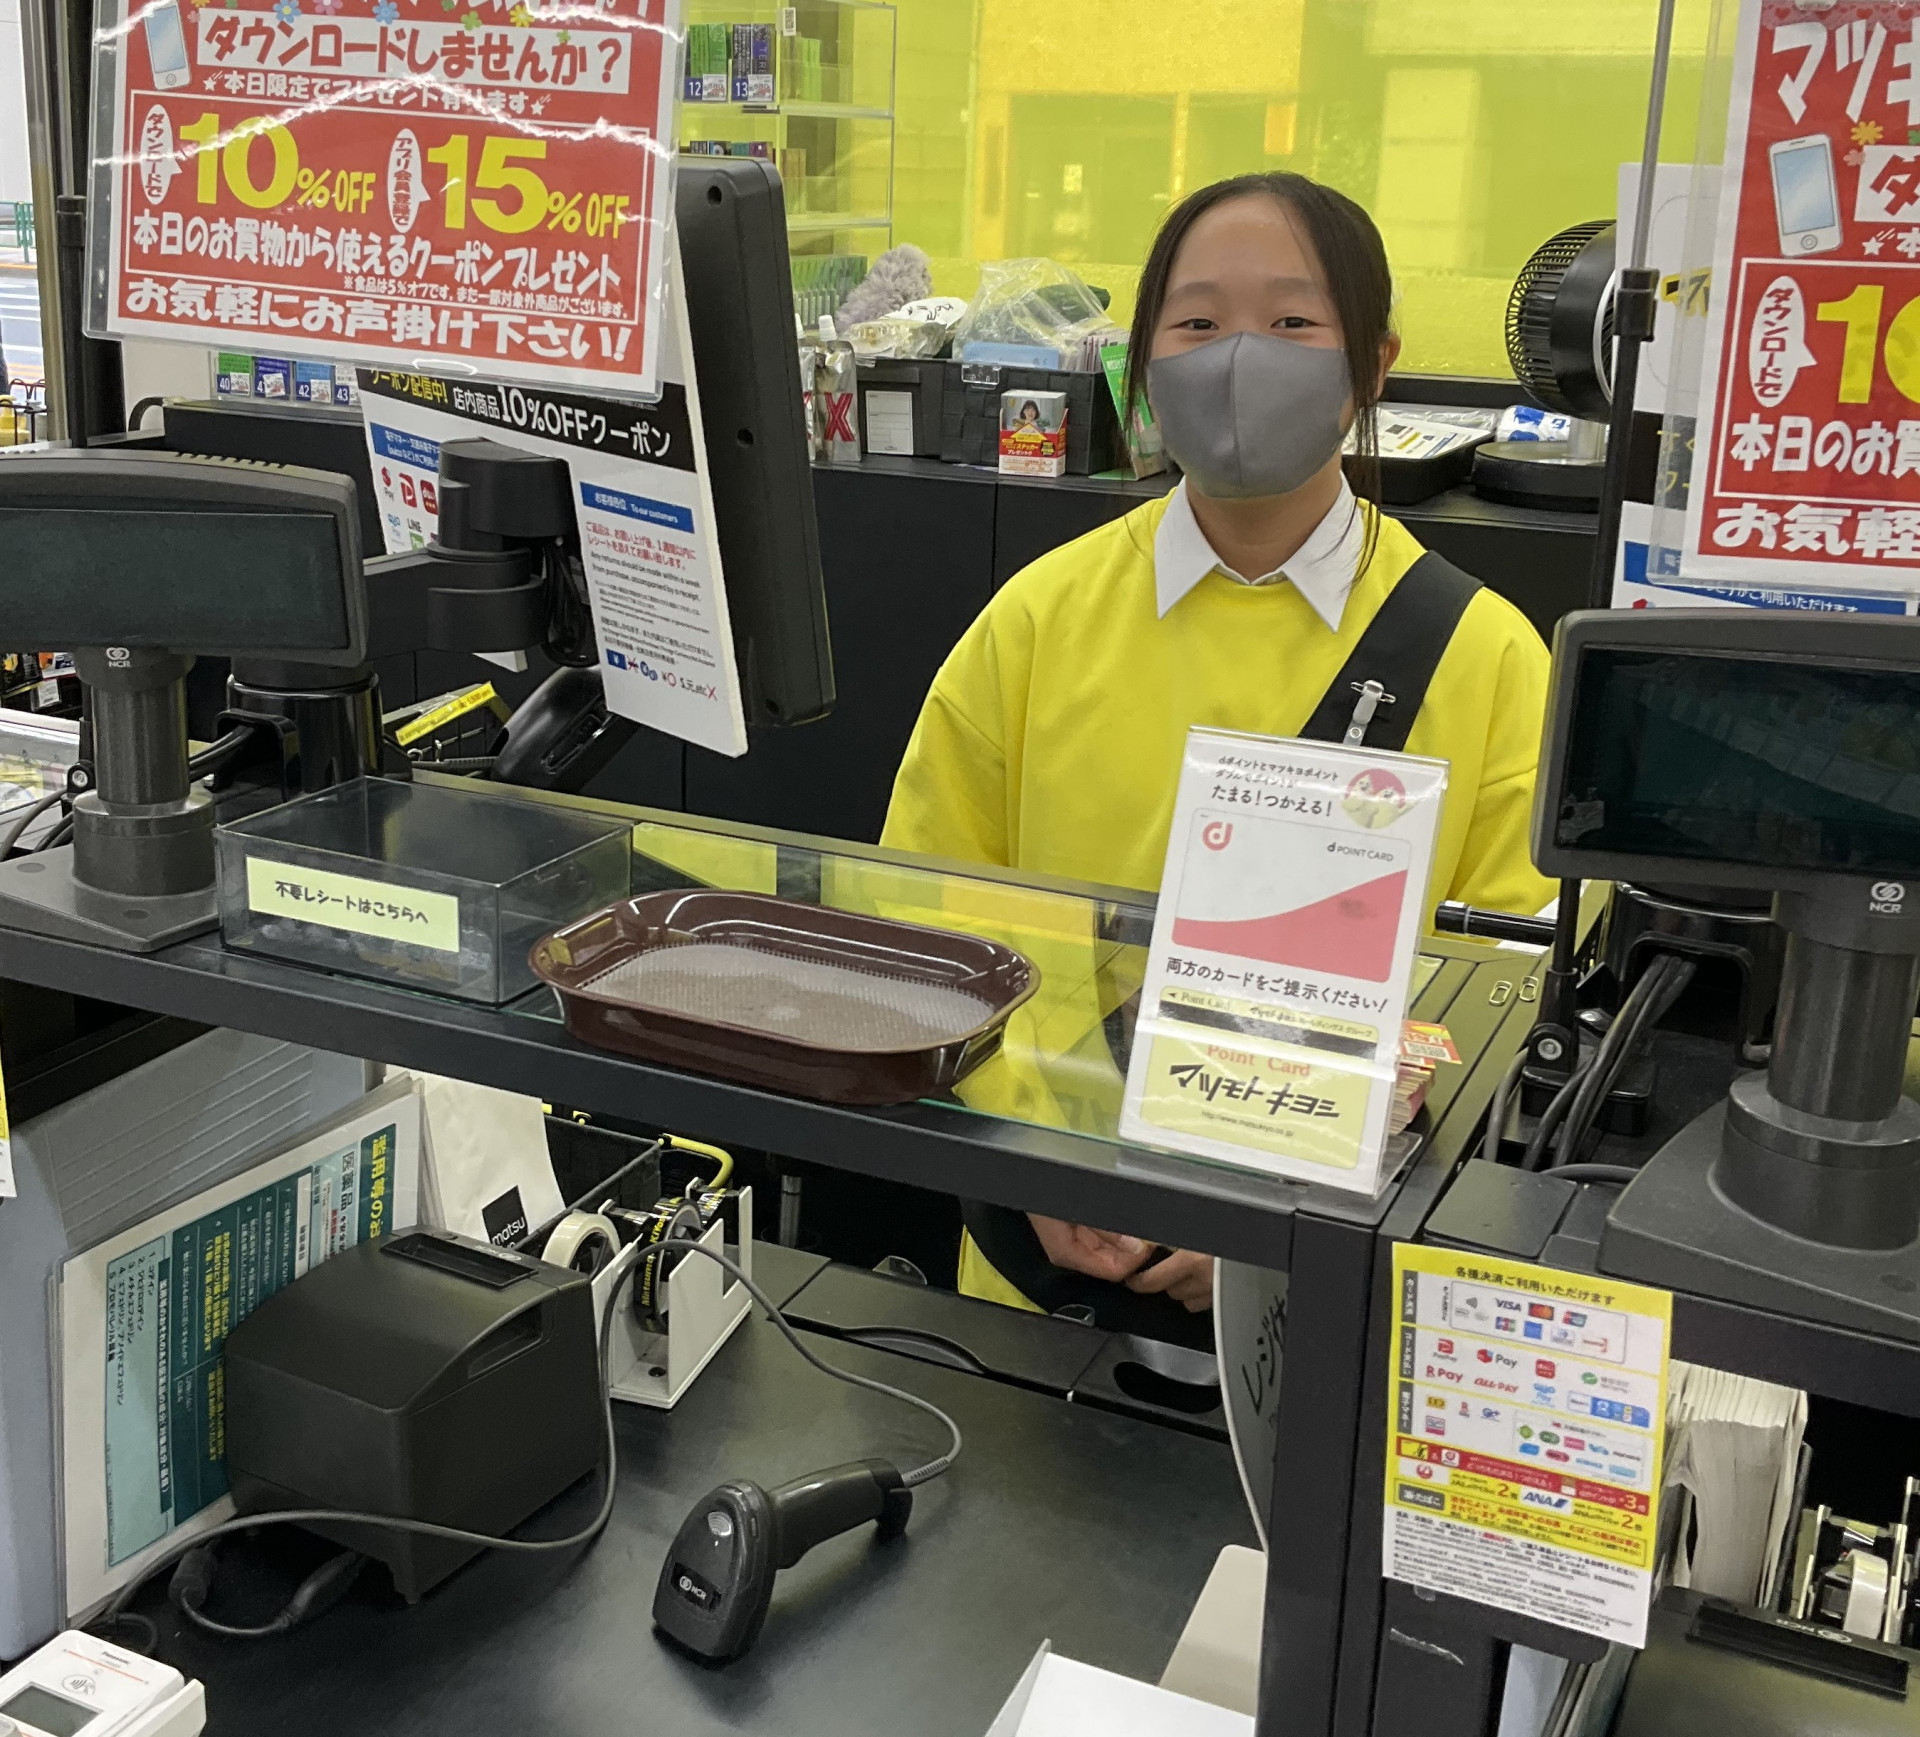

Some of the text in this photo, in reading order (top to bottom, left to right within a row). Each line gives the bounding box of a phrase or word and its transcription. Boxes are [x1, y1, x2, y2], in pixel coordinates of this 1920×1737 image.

[205, 15, 622, 86] ダウンロードしませんか？
[689, 81, 701, 97] 12
[735, 81, 748, 97] 13
[133, 212, 620, 298] 本日のお買物から使えるクーポンプレゼント
[126, 278, 632, 362] お気軽にお声掛け下さい！
[1754, 287, 1794, 398] ダウンロードで
[298, 384, 310, 398] 42
[336, 387, 348, 402] 43
[1211, 784, 1333, 818] たまる！つかえる！
[1337, 844, 1366, 858] POINT
[1367, 849, 1394, 862] CARD
[275, 880, 429, 925] 不要レシートはこちらへ
[1869, 901, 1902, 914] NCR
[1165, 956, 1389, 1014] 両方のカードをご提示ください！
[1206, 1044, 1312, 1077] Point Card
[492, 1216, 526, 1245] matsu
[1455, 1265, 1616, 1307] 各種決済ご利用いただけます
[1495, 1297, 1522, 1312] VISA
[1495, 1353, 1518, 1369] Pay
[1437, 1367, 1463, 1383] Pay
[1497, 1382, 1519, 1394] PAY
[1523, 1491, 1553, 1507] ANA
